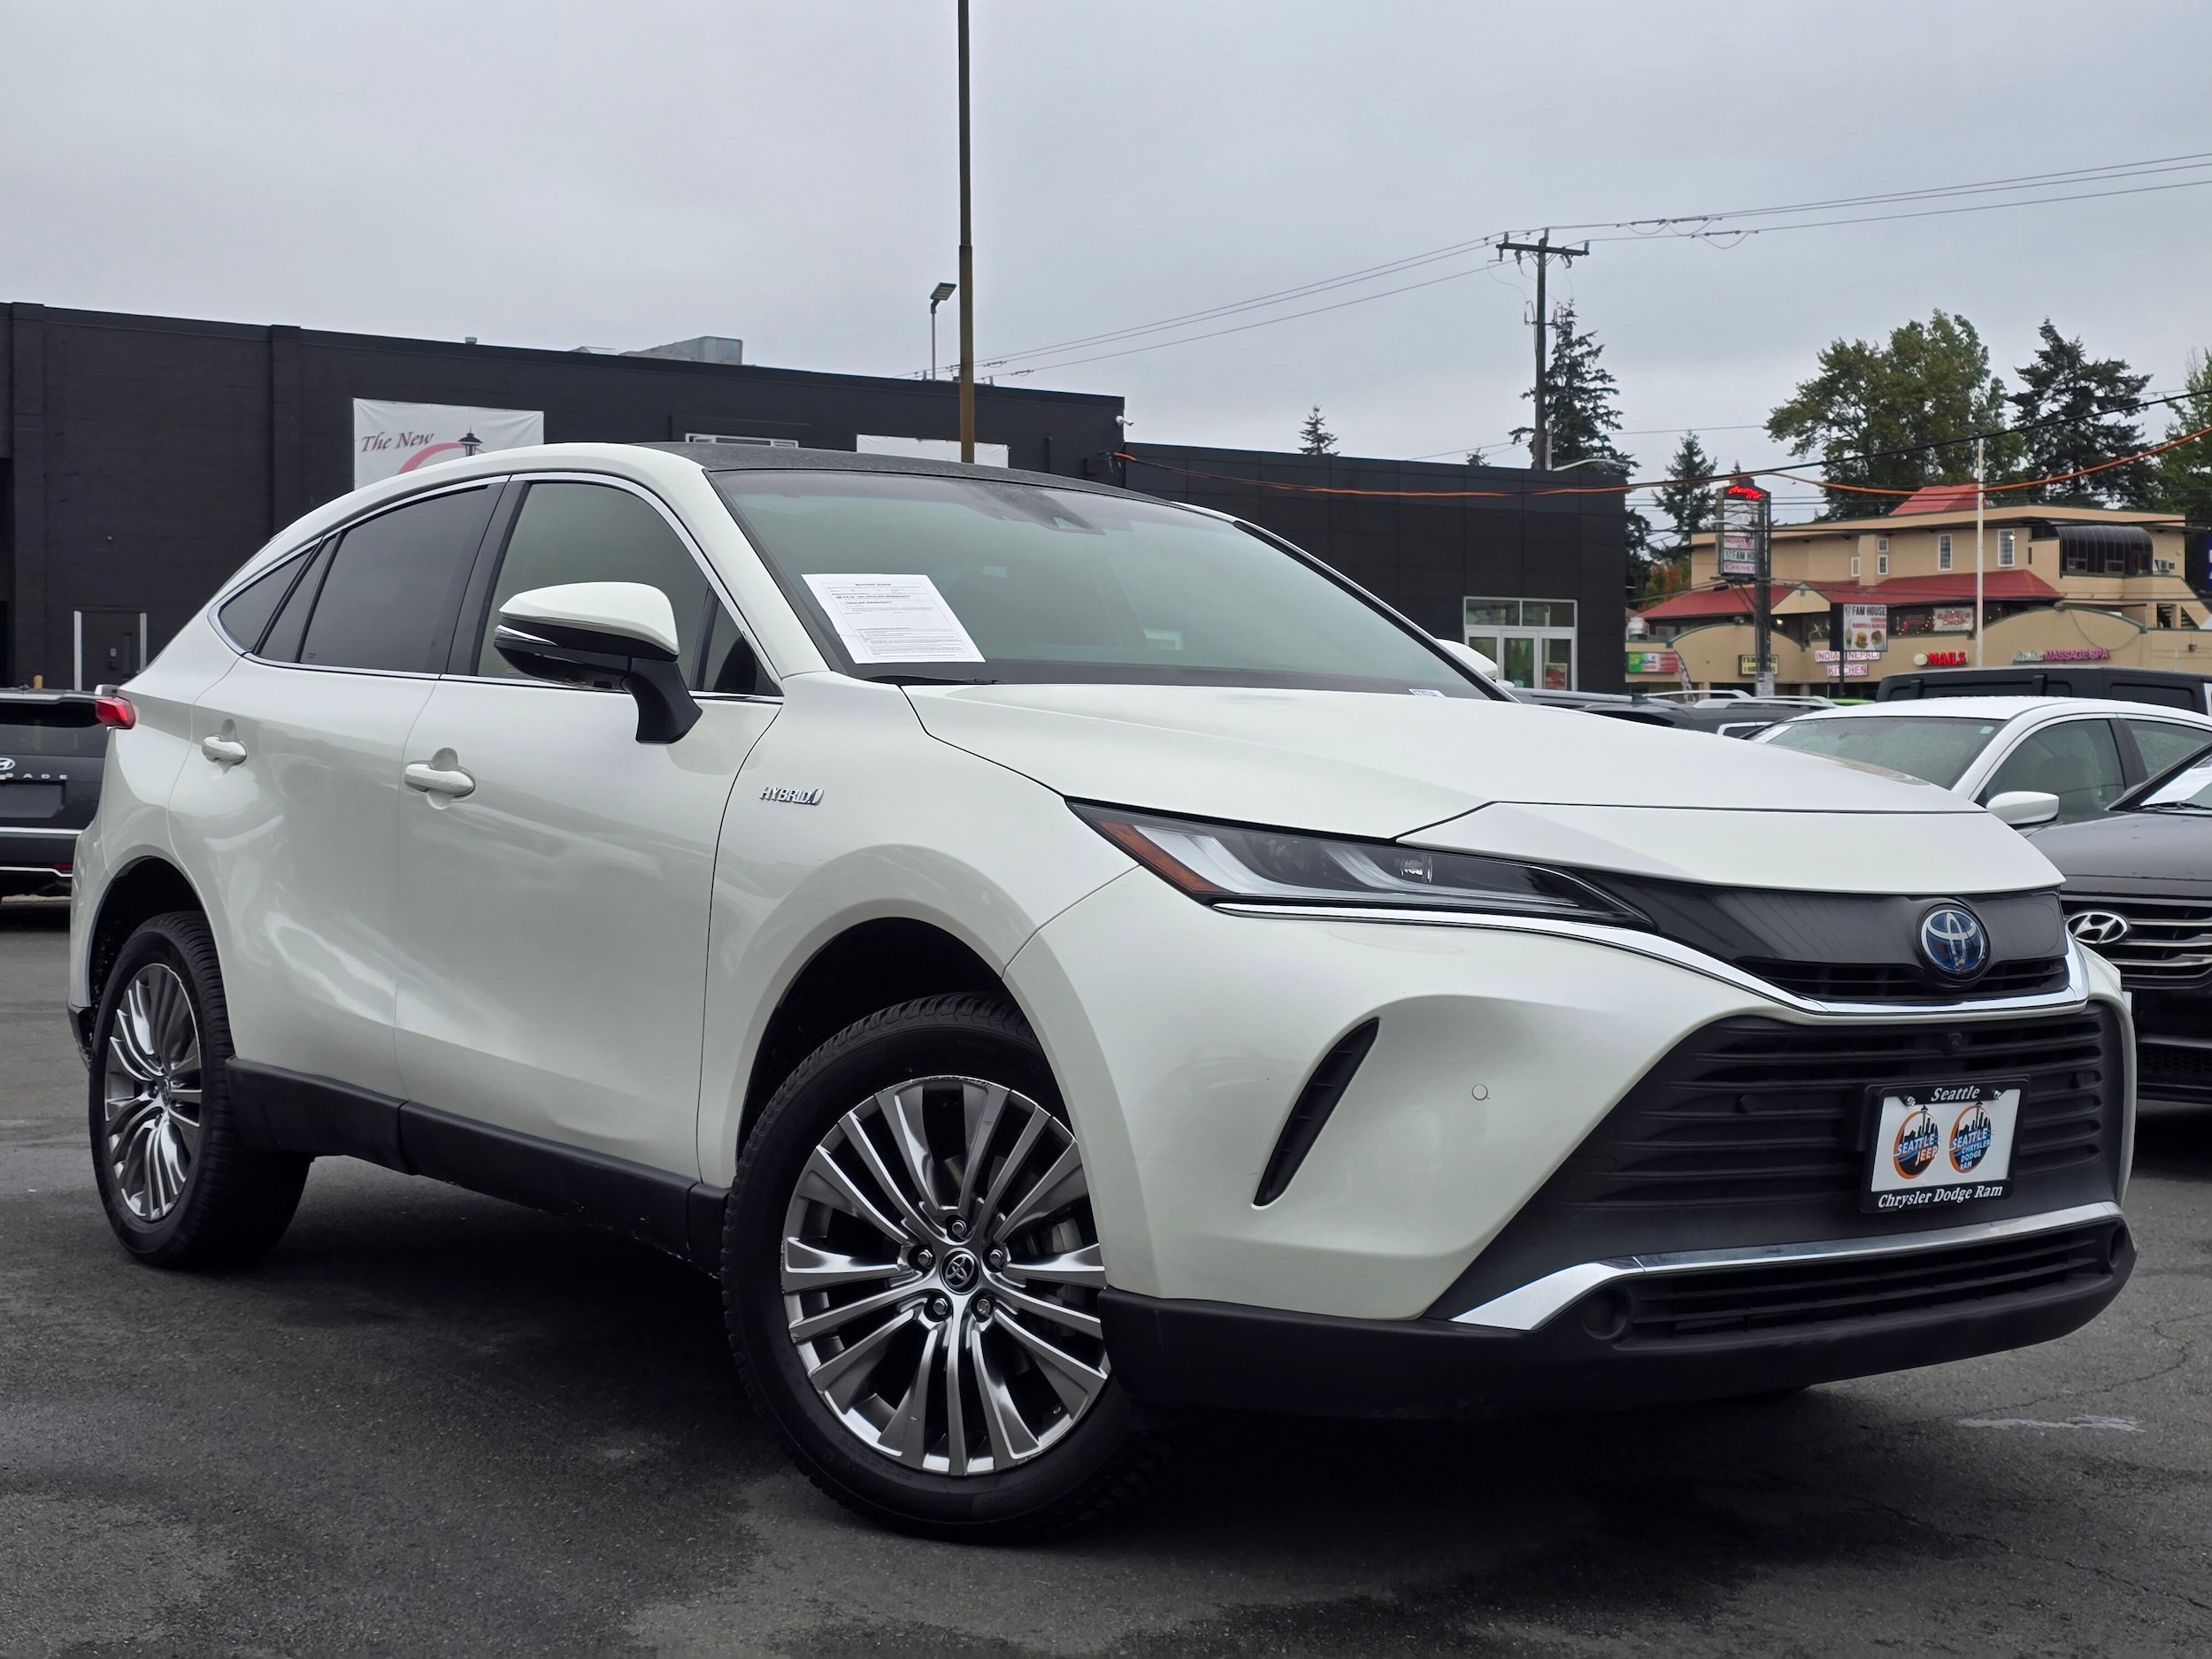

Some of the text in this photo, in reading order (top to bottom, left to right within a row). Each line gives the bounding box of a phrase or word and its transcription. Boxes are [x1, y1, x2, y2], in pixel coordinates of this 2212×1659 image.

[361, 431, 434, 452] The New
[1852, 606, 1886, 617] FAM HOUSE
[1816, 650, 1847, 662] INDIA
[1928, 651, 1967, 666] NAILS
[2044, 649, 2088, 661] MASSAGE
[2089, 649, 2109, 660] SPA
[759, 787, 813, 804] HYBRID
[1931, 1085, 1981, 1102] Seattle
[1897, 1133, 1936, 1156] SEATTLE
[1952, 1128, 1989, 1148] SEATTLE
[1915, 1144, 1938, 1166] JEEP
[1961, 1139, 1991, 1155] CHRYSLER
[1961, 1149, 1982, 1163] DODGE
[1960, 1160, 1973, 1171] RAM
[1878, 1184, 2003, 1210] Chrysler Dodge Ram
